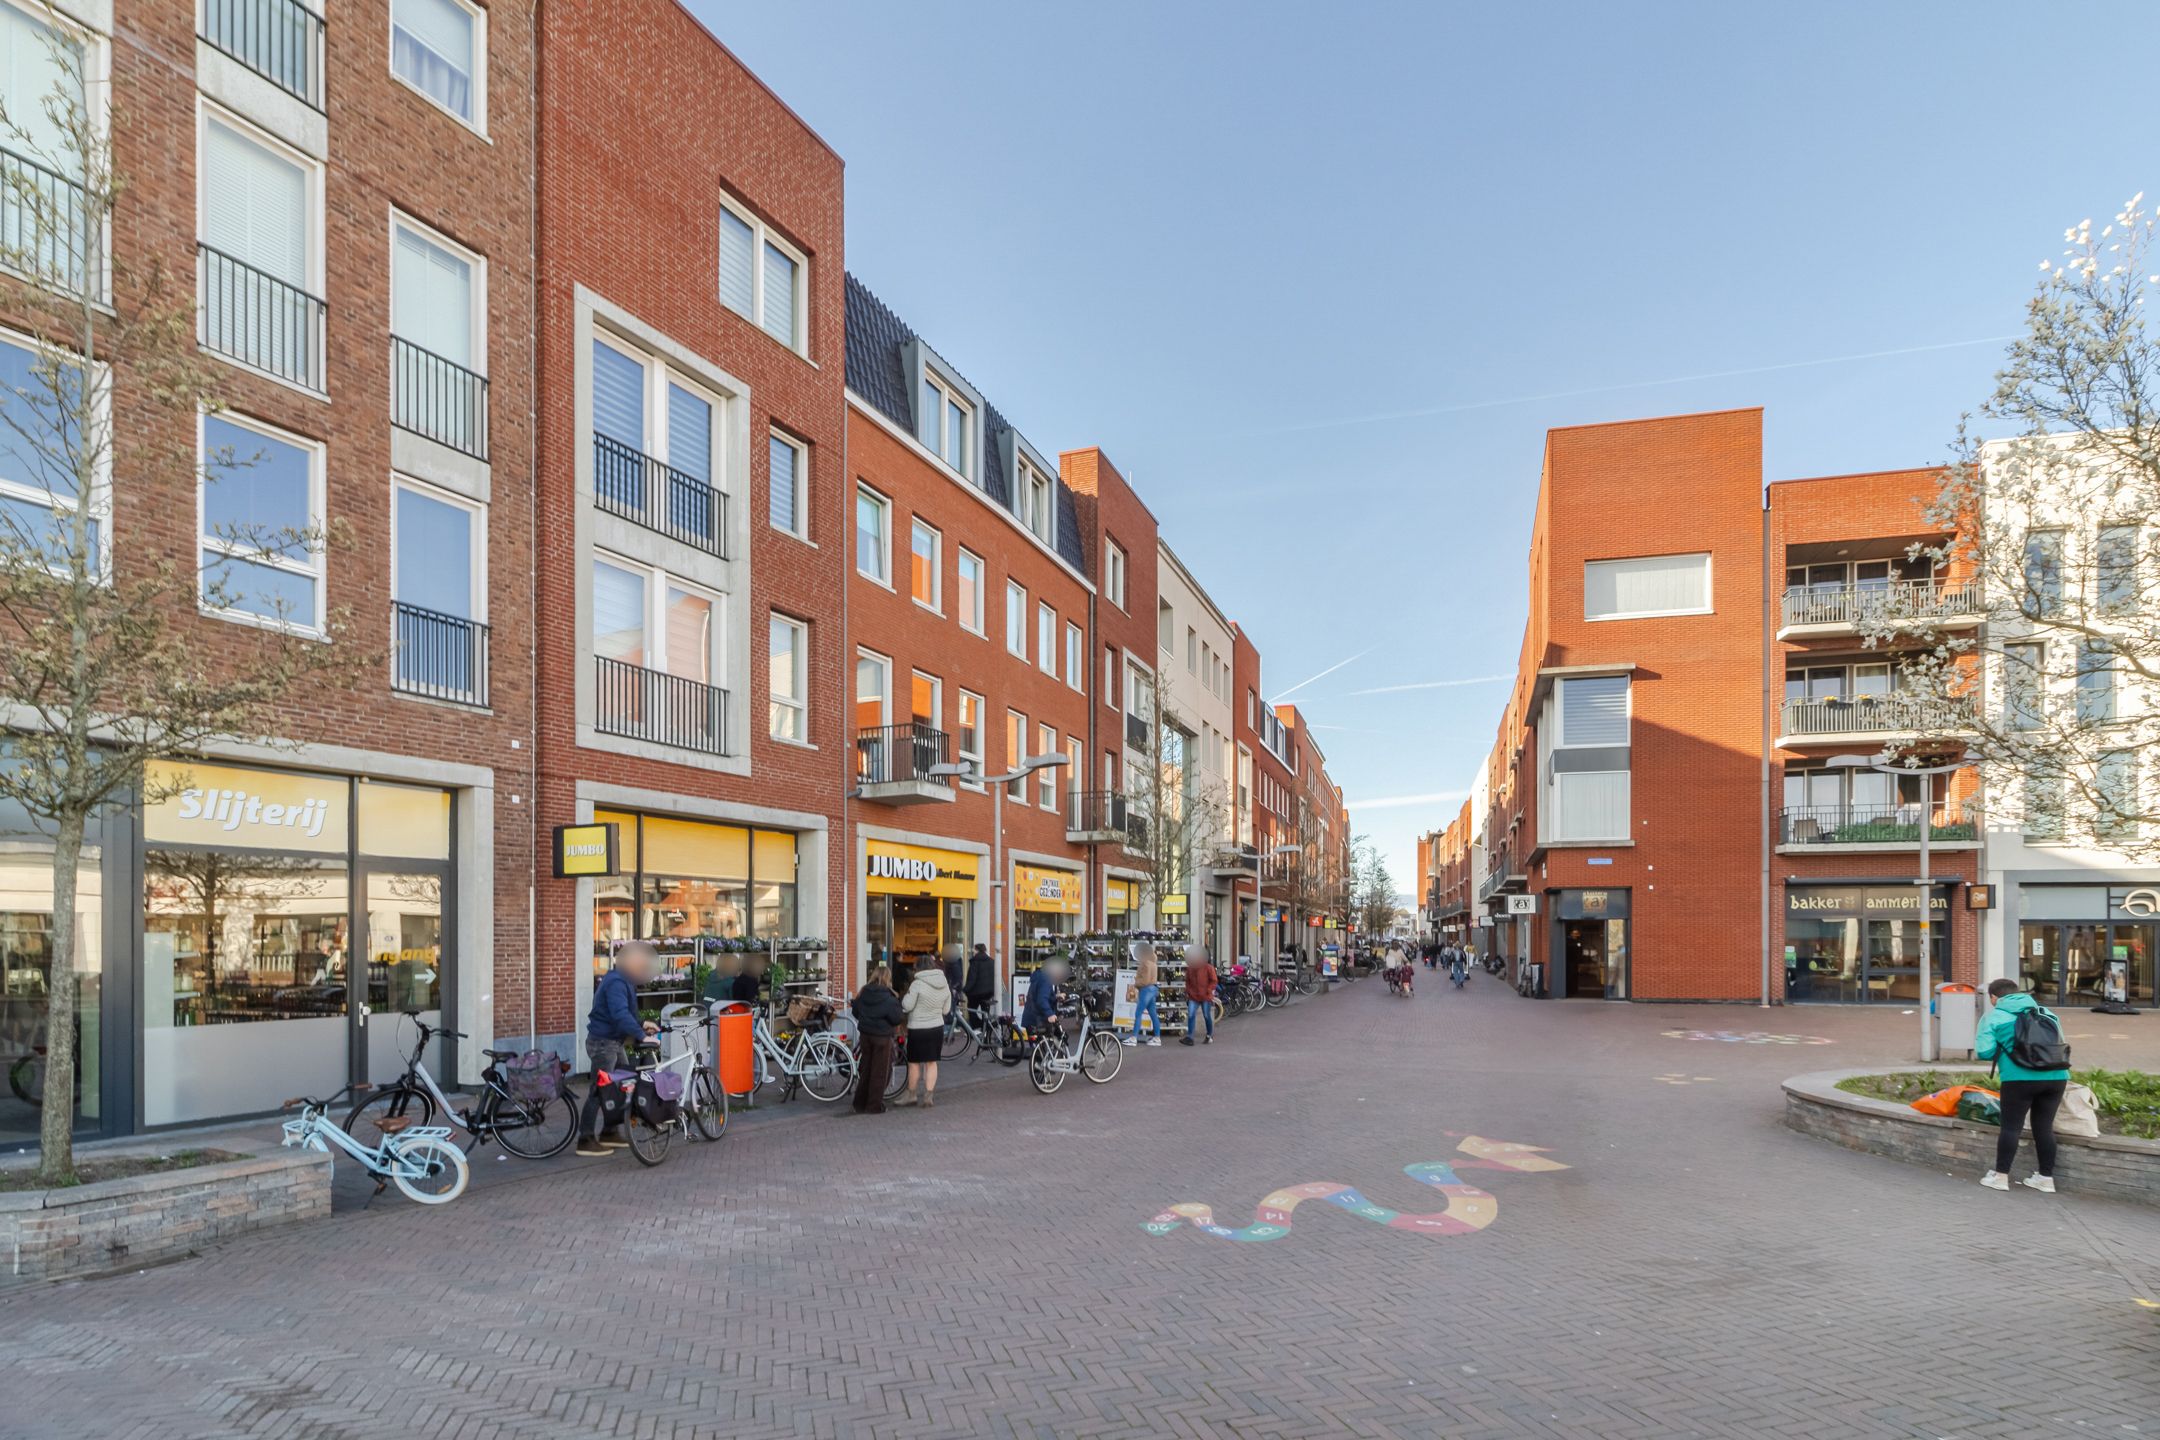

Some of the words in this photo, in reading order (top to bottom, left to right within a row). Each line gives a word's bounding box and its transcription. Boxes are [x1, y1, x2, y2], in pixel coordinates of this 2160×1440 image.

[178, 788, 328, 837] Slijterij
[566, 844, 605, 857] JUMBO
[870, 855, 937, 881] JUMBO
[1791, 895, 1842, 910] bakker
[1866, 896, 1948, 909] ammerlan
[1264, 1211, 1284, 1221] 14
[1147, 1222, 1170, 1232] 20
